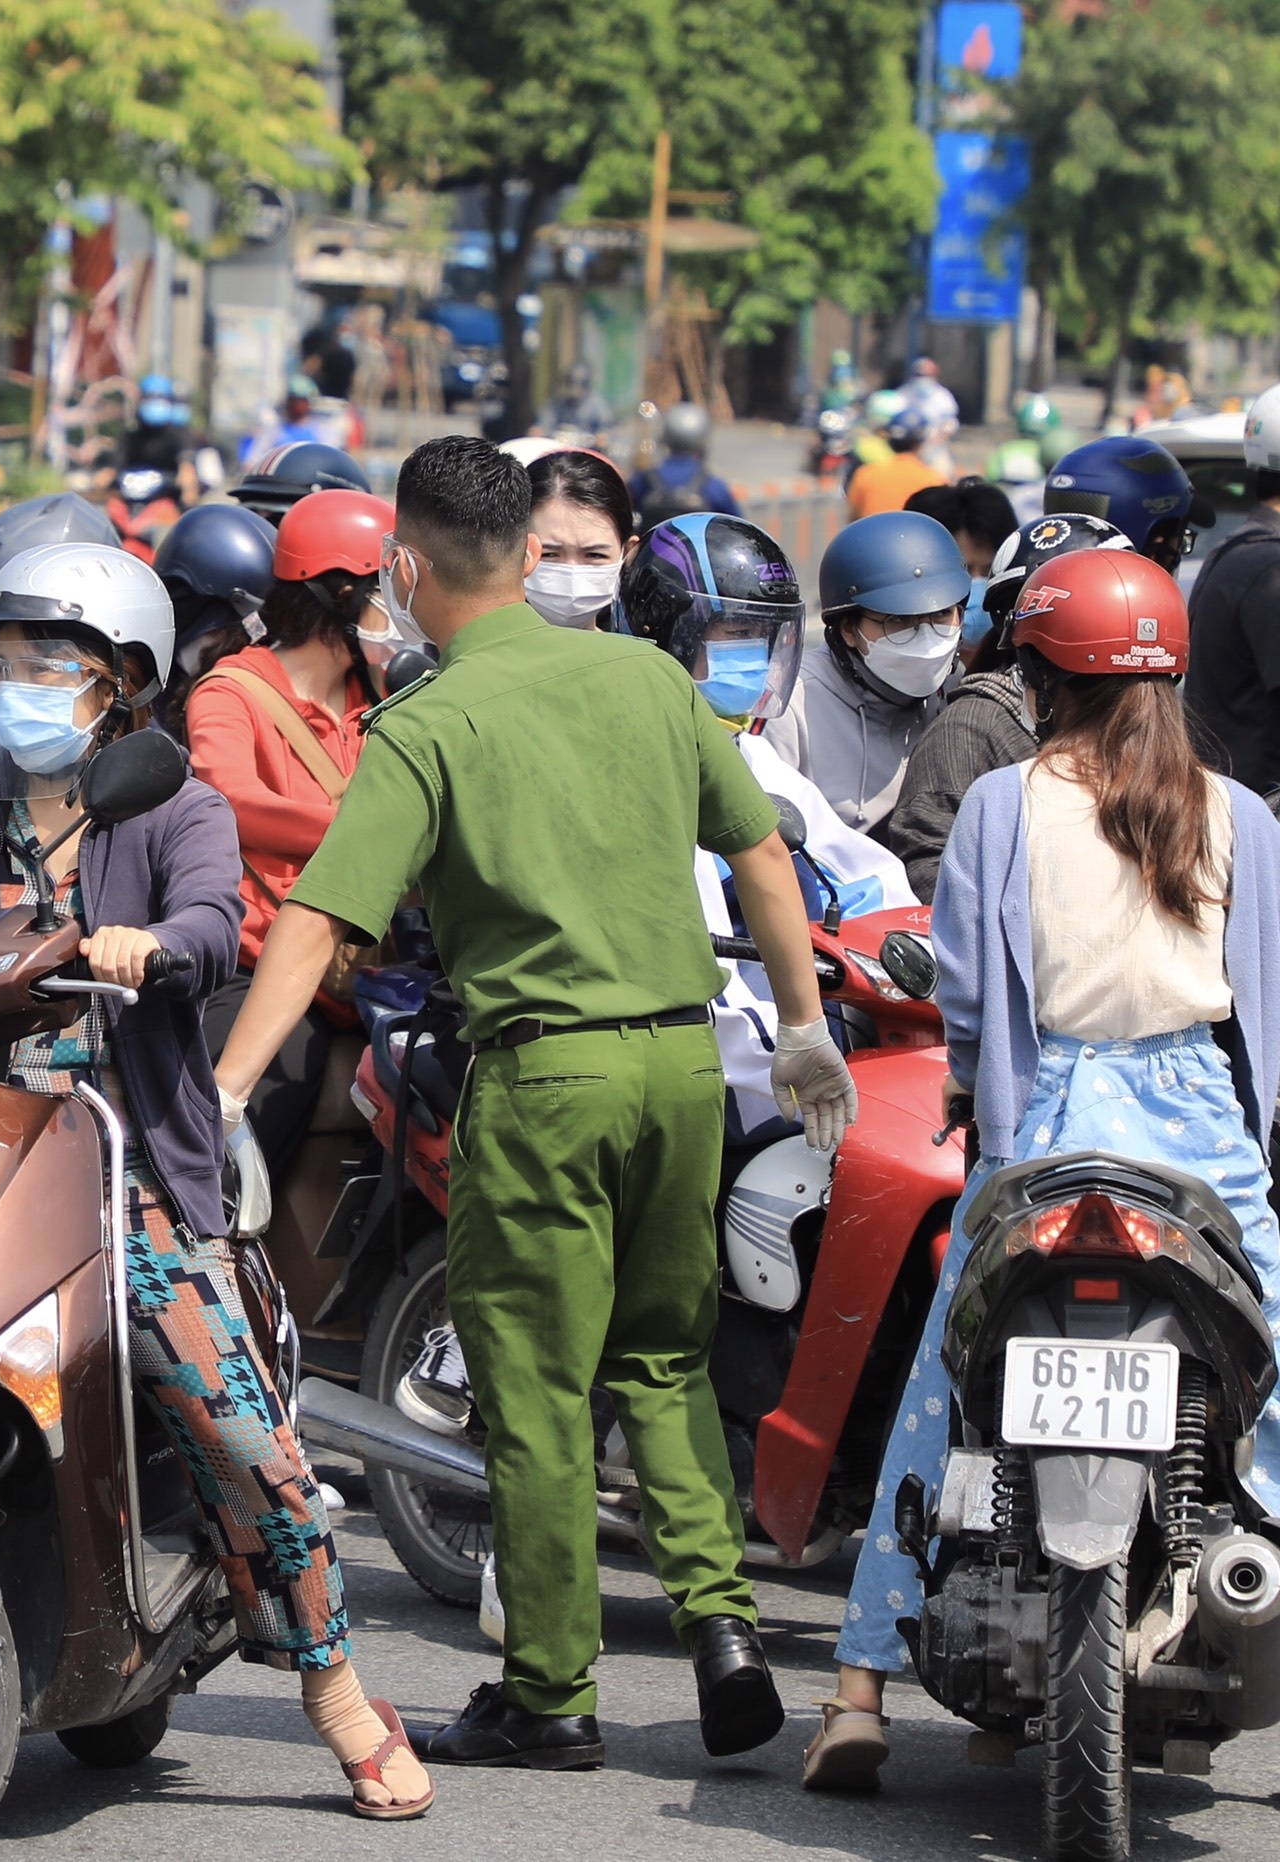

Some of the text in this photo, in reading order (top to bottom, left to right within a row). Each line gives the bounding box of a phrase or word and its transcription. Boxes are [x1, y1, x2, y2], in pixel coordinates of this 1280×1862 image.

[1110, 653, 1144, 667] TÂN
[1131, 645, 1166, 656] Honda
[1032, 1347, 1151, 1393] 66-N6
[1028, 1393, 1149, 1440] 4210
